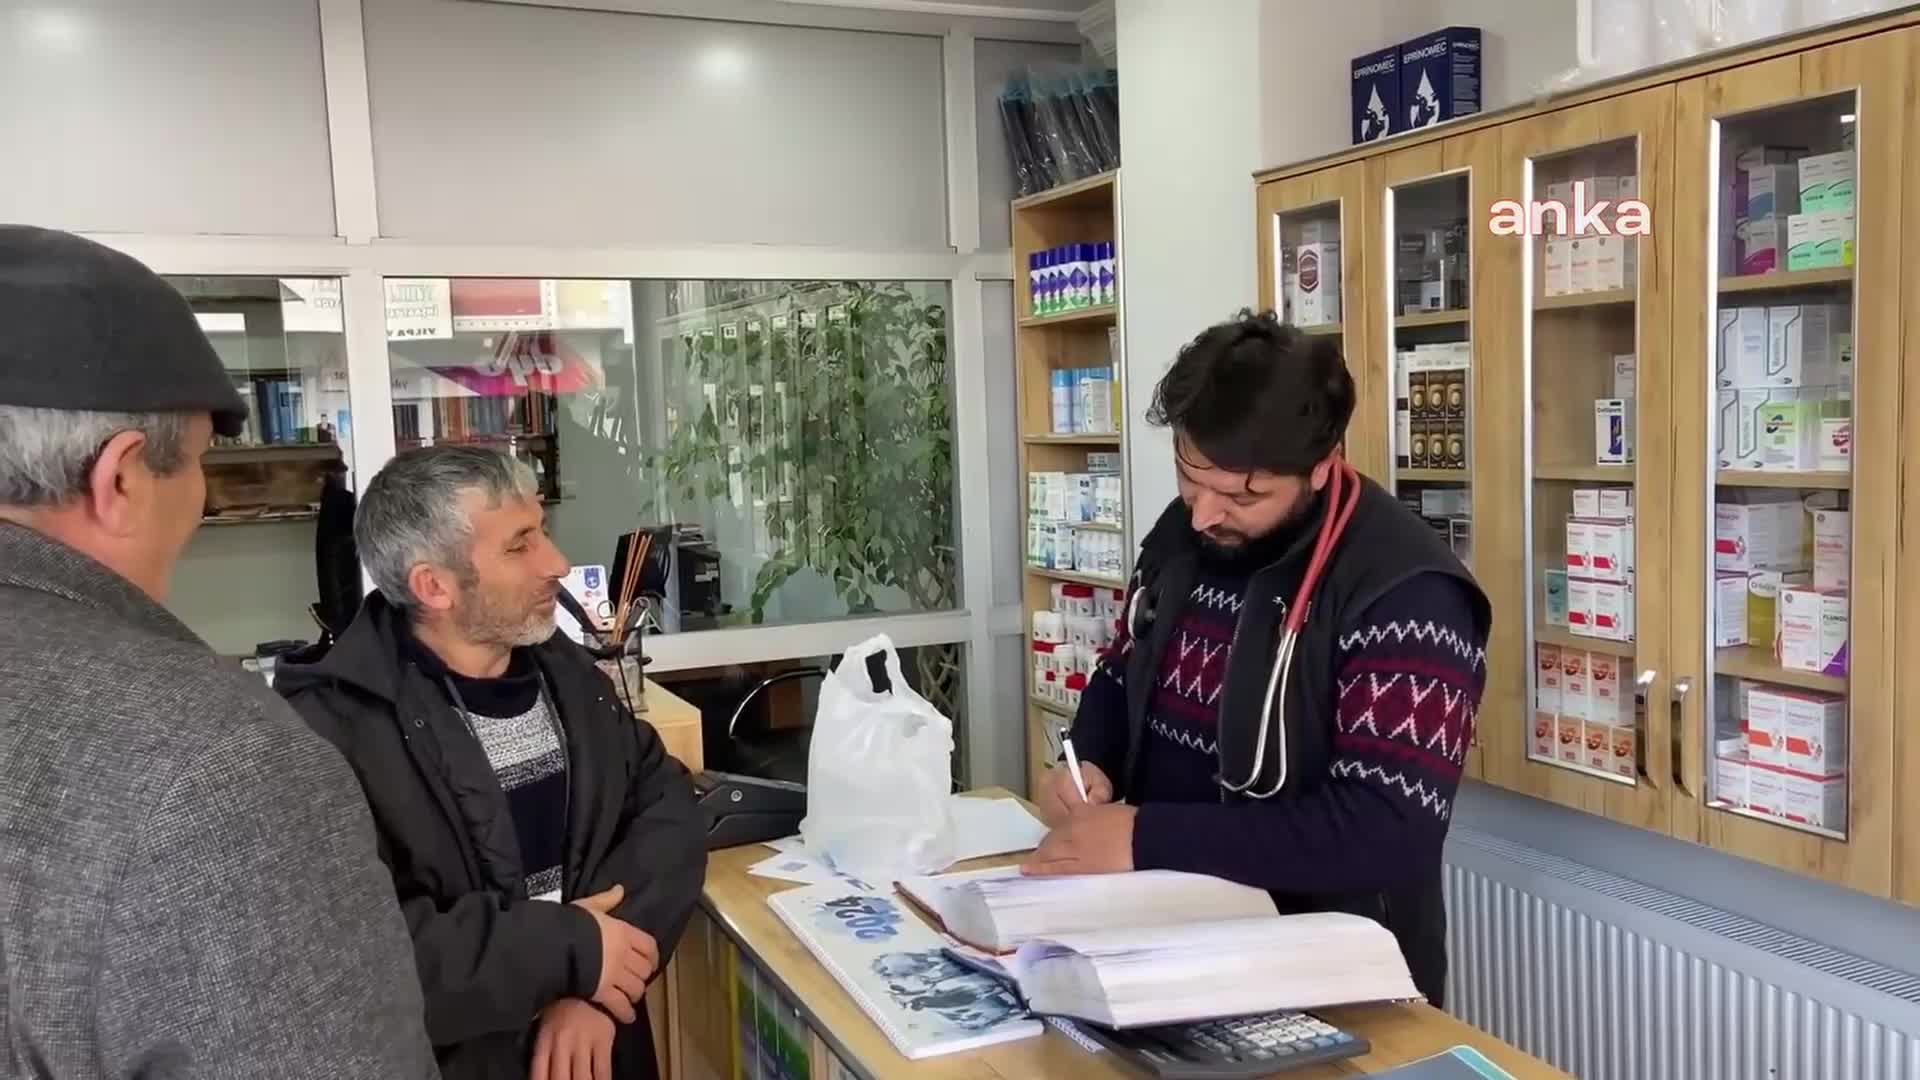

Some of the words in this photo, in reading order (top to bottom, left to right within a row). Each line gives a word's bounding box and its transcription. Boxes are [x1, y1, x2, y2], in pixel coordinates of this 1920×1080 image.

[1403, 41, 1447, 64] EPRINOMEC
[1353, 58, 1395, 79] EPRINOMEC
[824, 896, 899, 939] 2024
